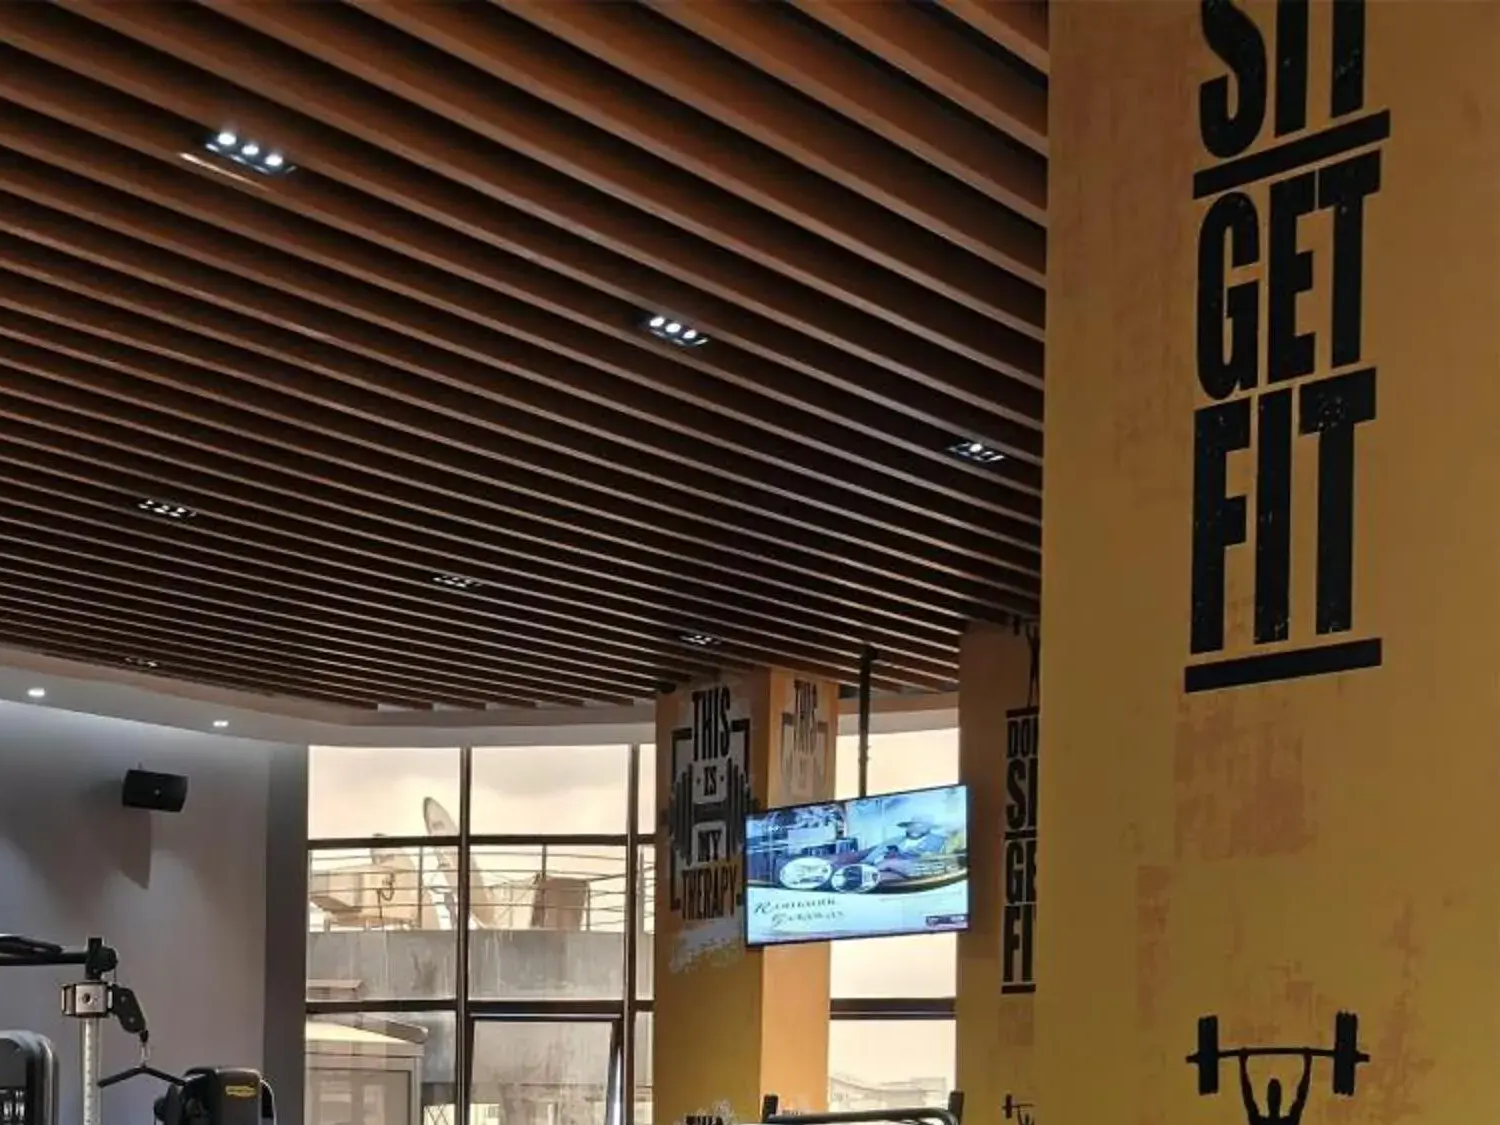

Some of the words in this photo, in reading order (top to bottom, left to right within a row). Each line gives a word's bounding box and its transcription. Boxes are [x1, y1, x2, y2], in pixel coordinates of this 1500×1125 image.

[1196, 148, 1382, 401] GET
[1190, 366, 1377, 655] FIT
[692, 685, 731, 761] THIS
[1006, 757, 1038, 831] SI
[681, 864, 738, 921] THERAPY
[1005, 838, 1037, 904] GE
[1002, 903, 1037, 983] FI
